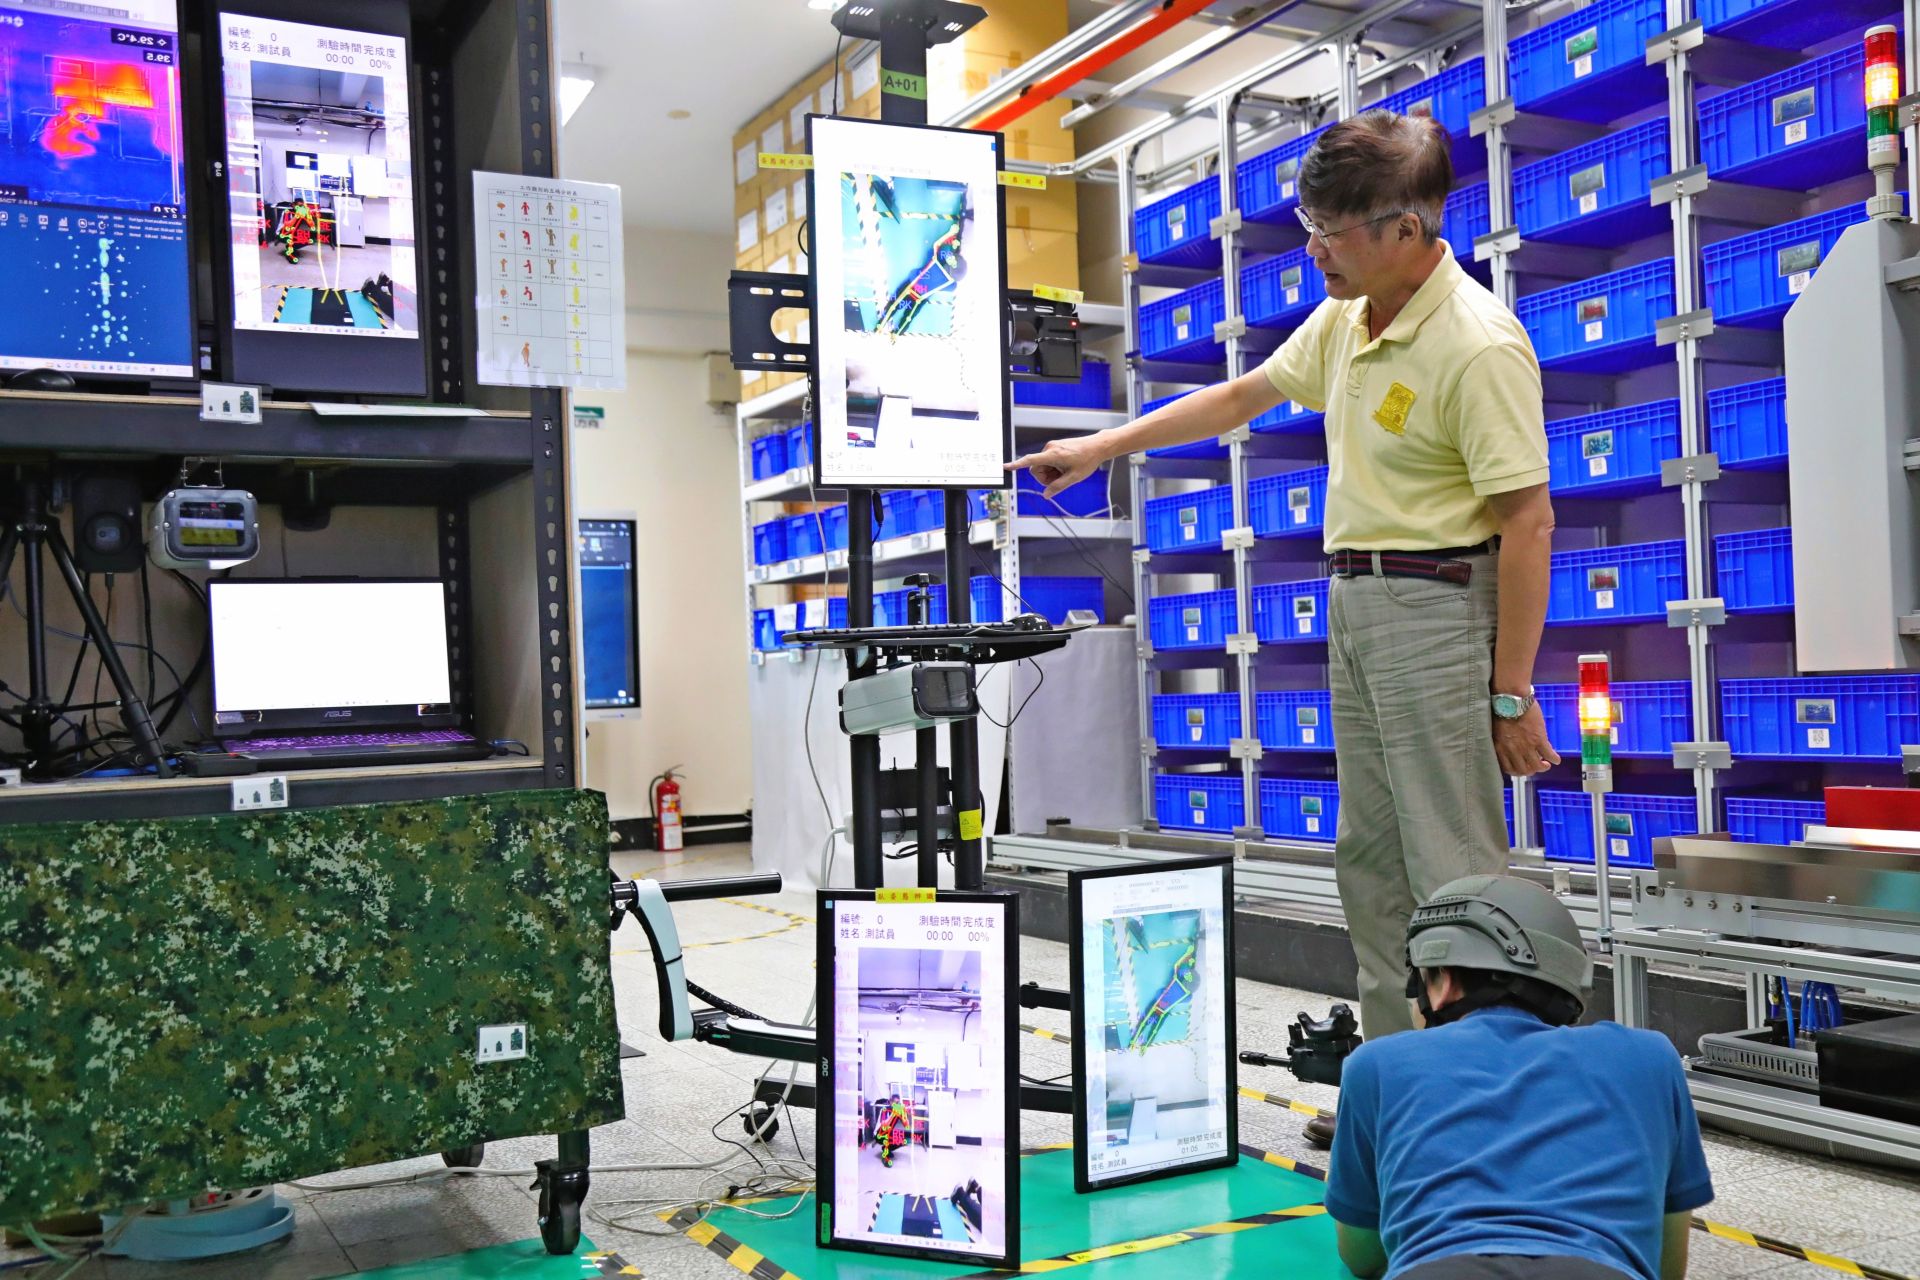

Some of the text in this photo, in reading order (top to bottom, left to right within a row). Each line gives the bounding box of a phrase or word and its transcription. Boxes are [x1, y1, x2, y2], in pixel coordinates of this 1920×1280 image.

[257, 43, 292, 58] 測試員
[325, 53, 392, 70] 00:00 00%
[884, 75, 918, 93] A+01
[324, 710, 352, 718] ASUS
[877, 915, 884, 925] 0
[865, 928, 895, 940] 測試員
[926, 930, 990, 942] 00:00 00%
[821, 1056, 829, 1077] AOC
